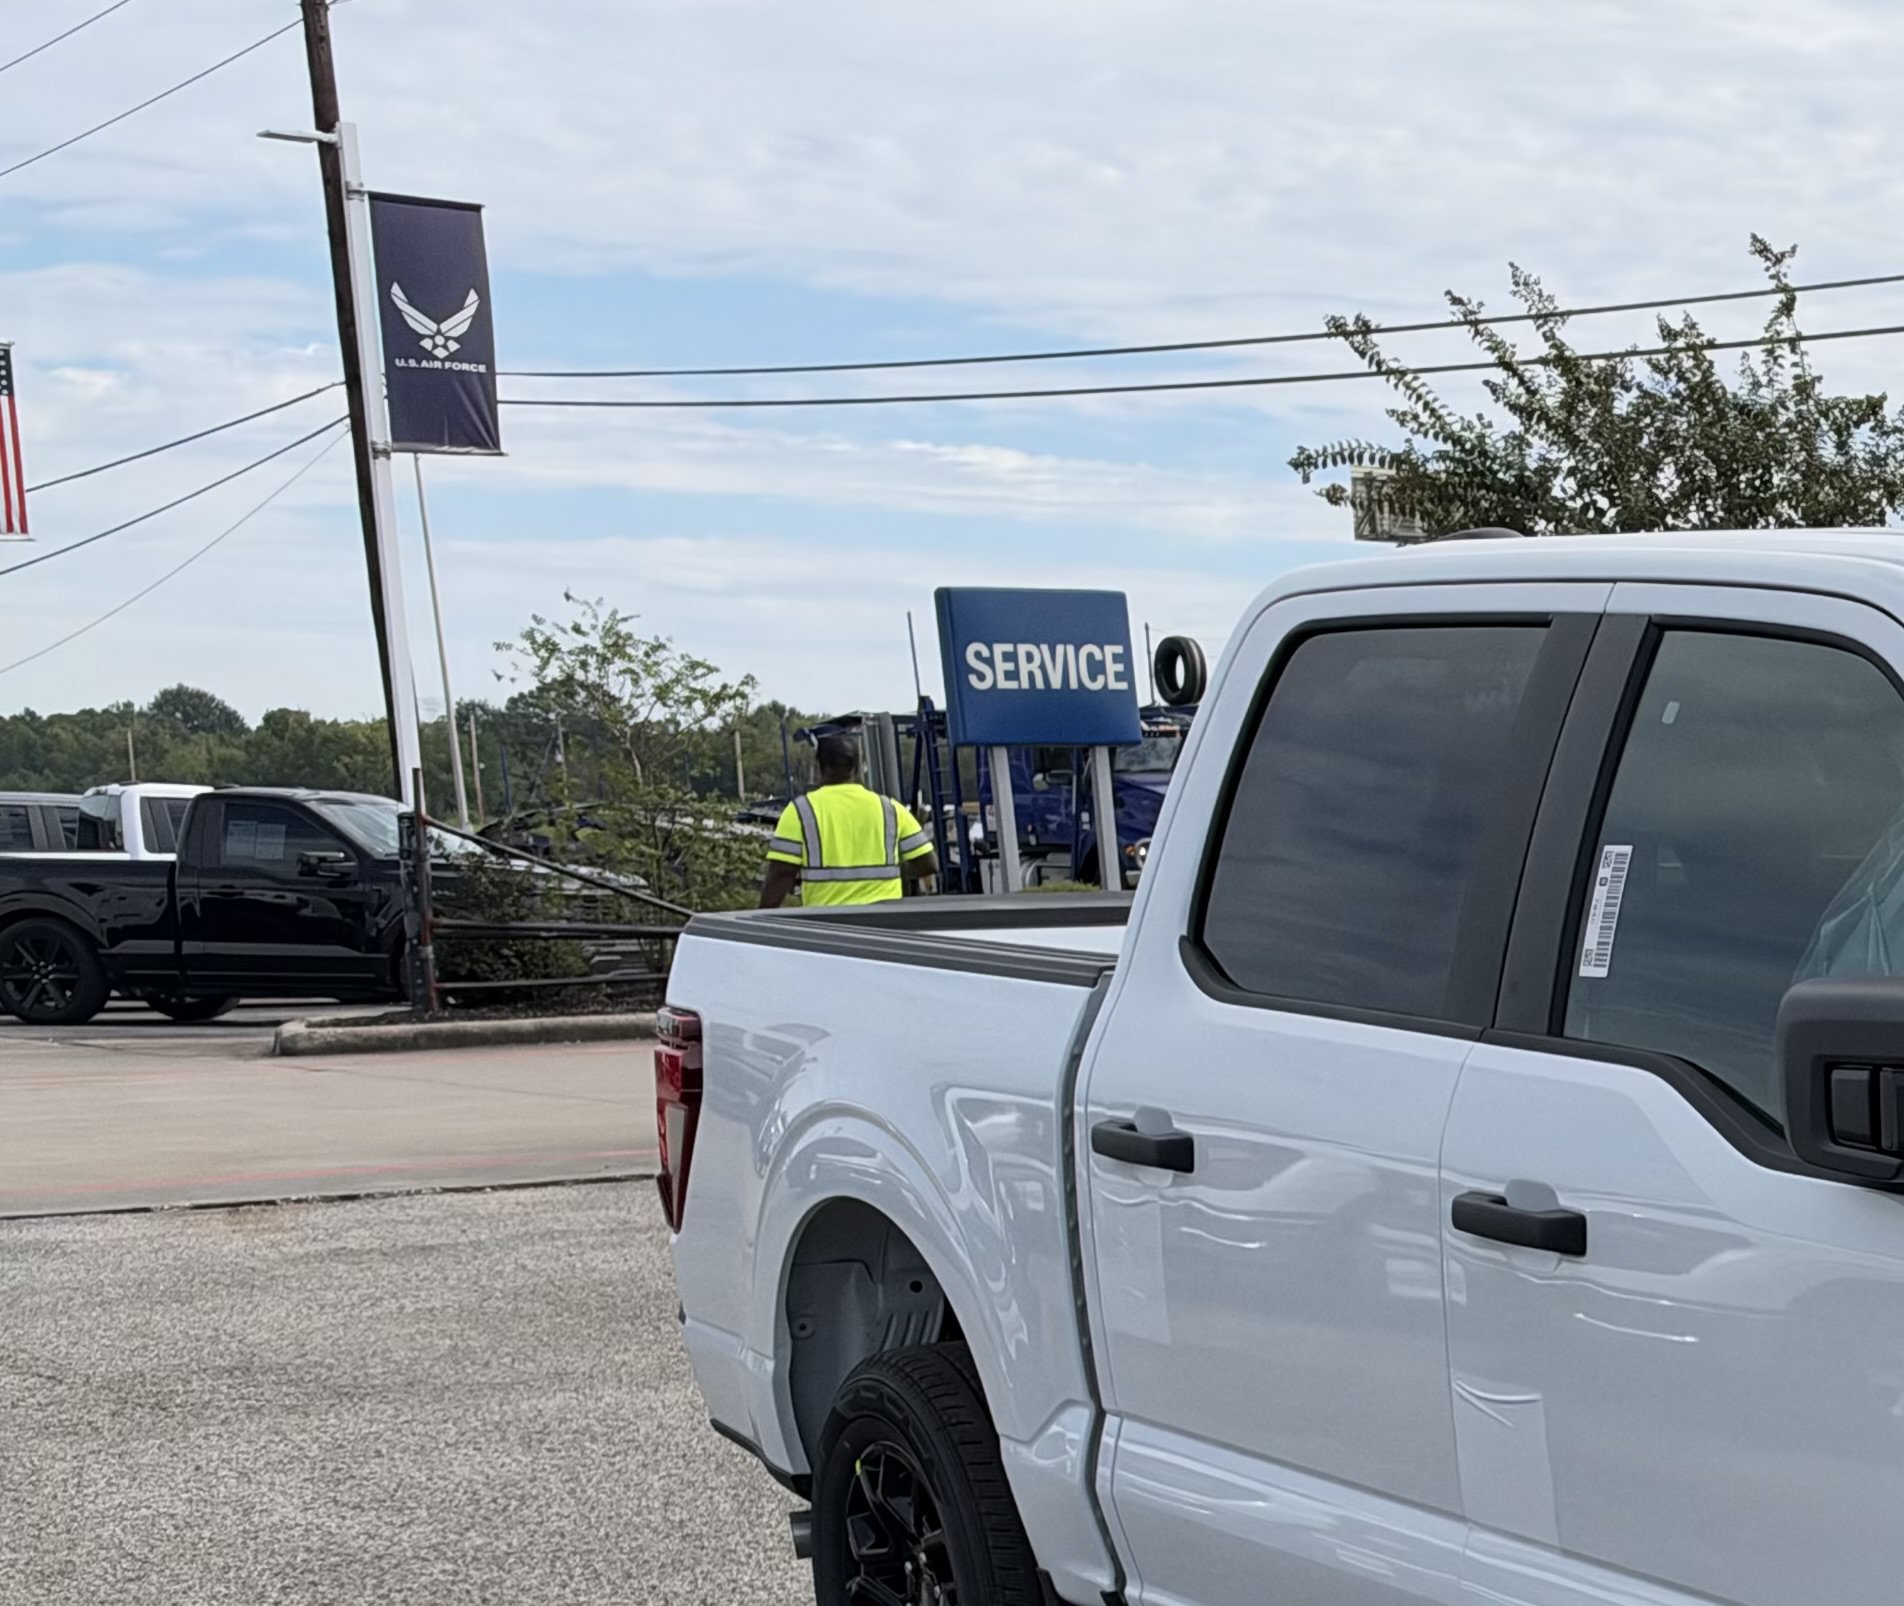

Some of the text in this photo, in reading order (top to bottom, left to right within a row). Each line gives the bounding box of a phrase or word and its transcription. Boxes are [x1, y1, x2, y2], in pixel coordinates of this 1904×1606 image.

[395, 358, 487, 373] U.S. AIR FORCE
[965, 642, 1129, 691] SERVICE
